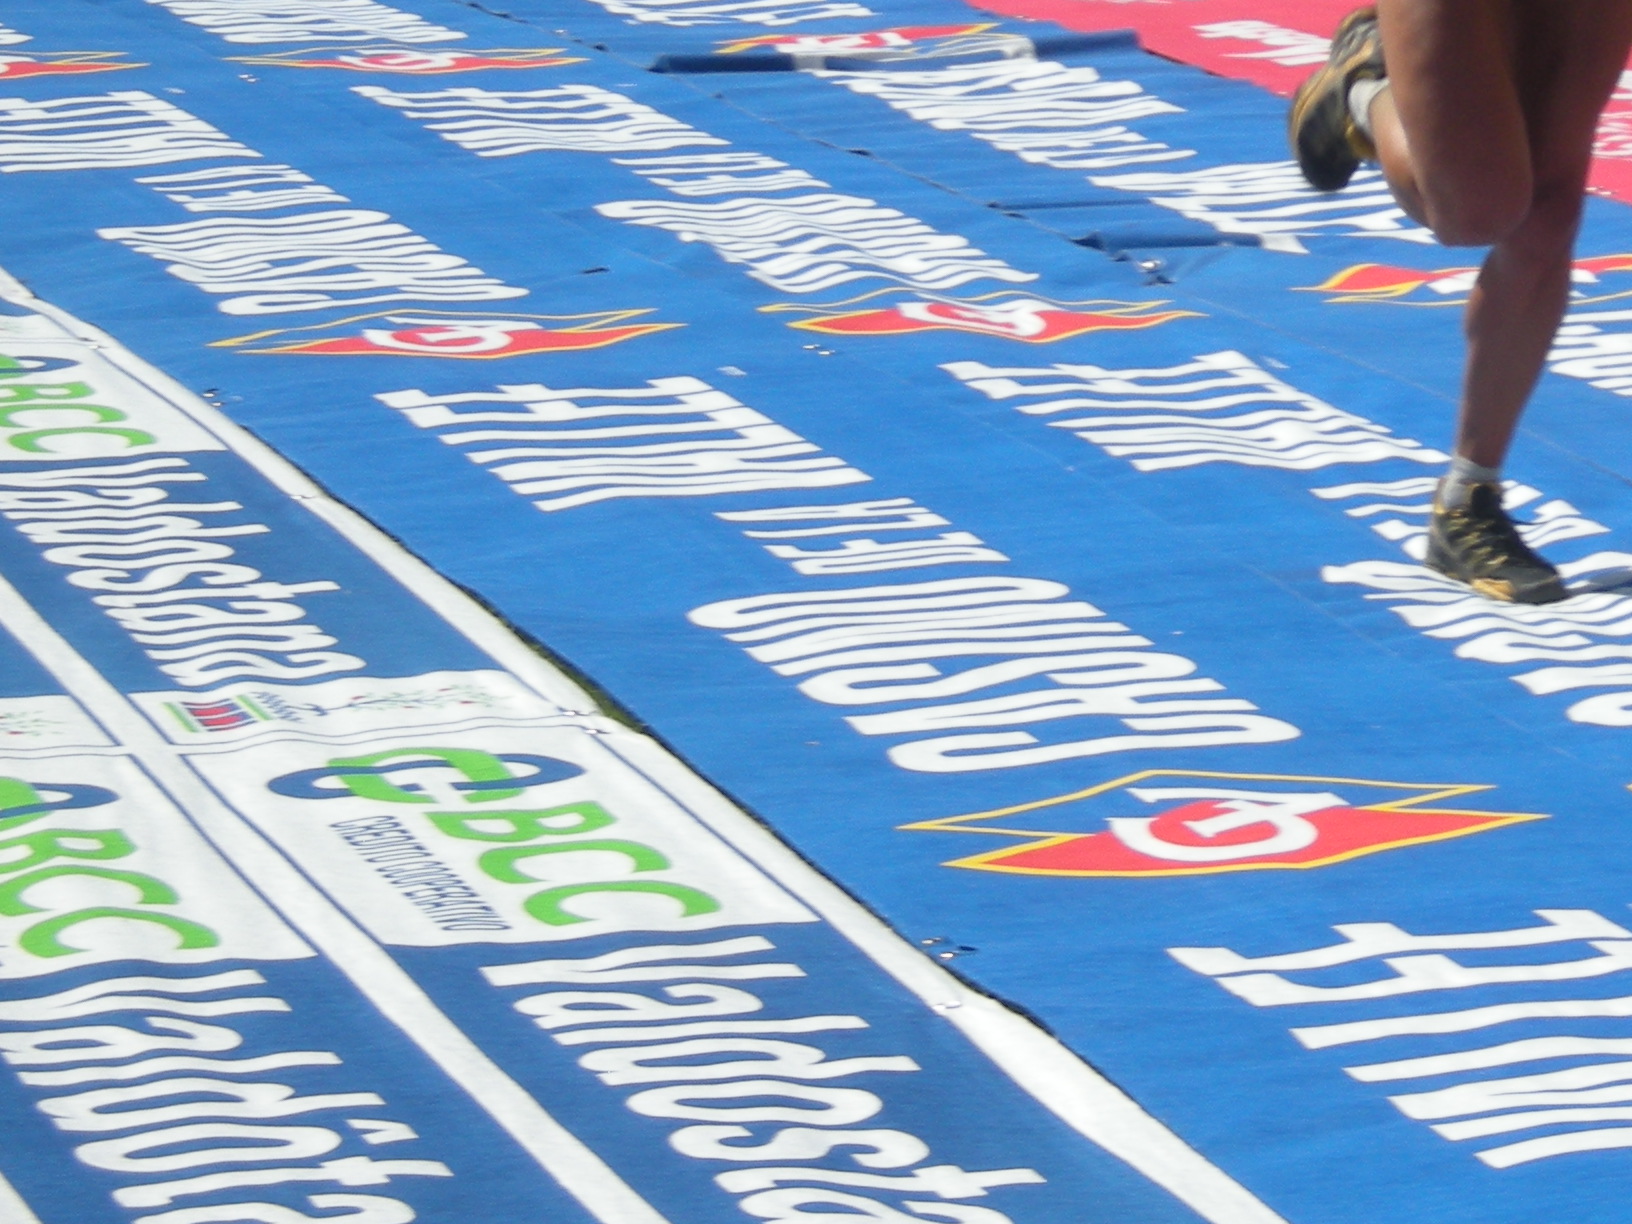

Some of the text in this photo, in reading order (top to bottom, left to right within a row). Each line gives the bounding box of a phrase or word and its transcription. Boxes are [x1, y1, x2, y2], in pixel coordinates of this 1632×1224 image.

[134, 165, 314, 191] LA
[166, 187, 350, 212] DE
[96, 210, 529, 315] CASINO
[938, 352, 1471, 472] VALLEE
[0, 458, 366, 685] Valdostana
[373, 376, 1301, 772] CASINO DE LA VALLEE
[331, 816, 510, 930] CREDITO COOPERATIVO
[429, 804, 717, 925] BCC
